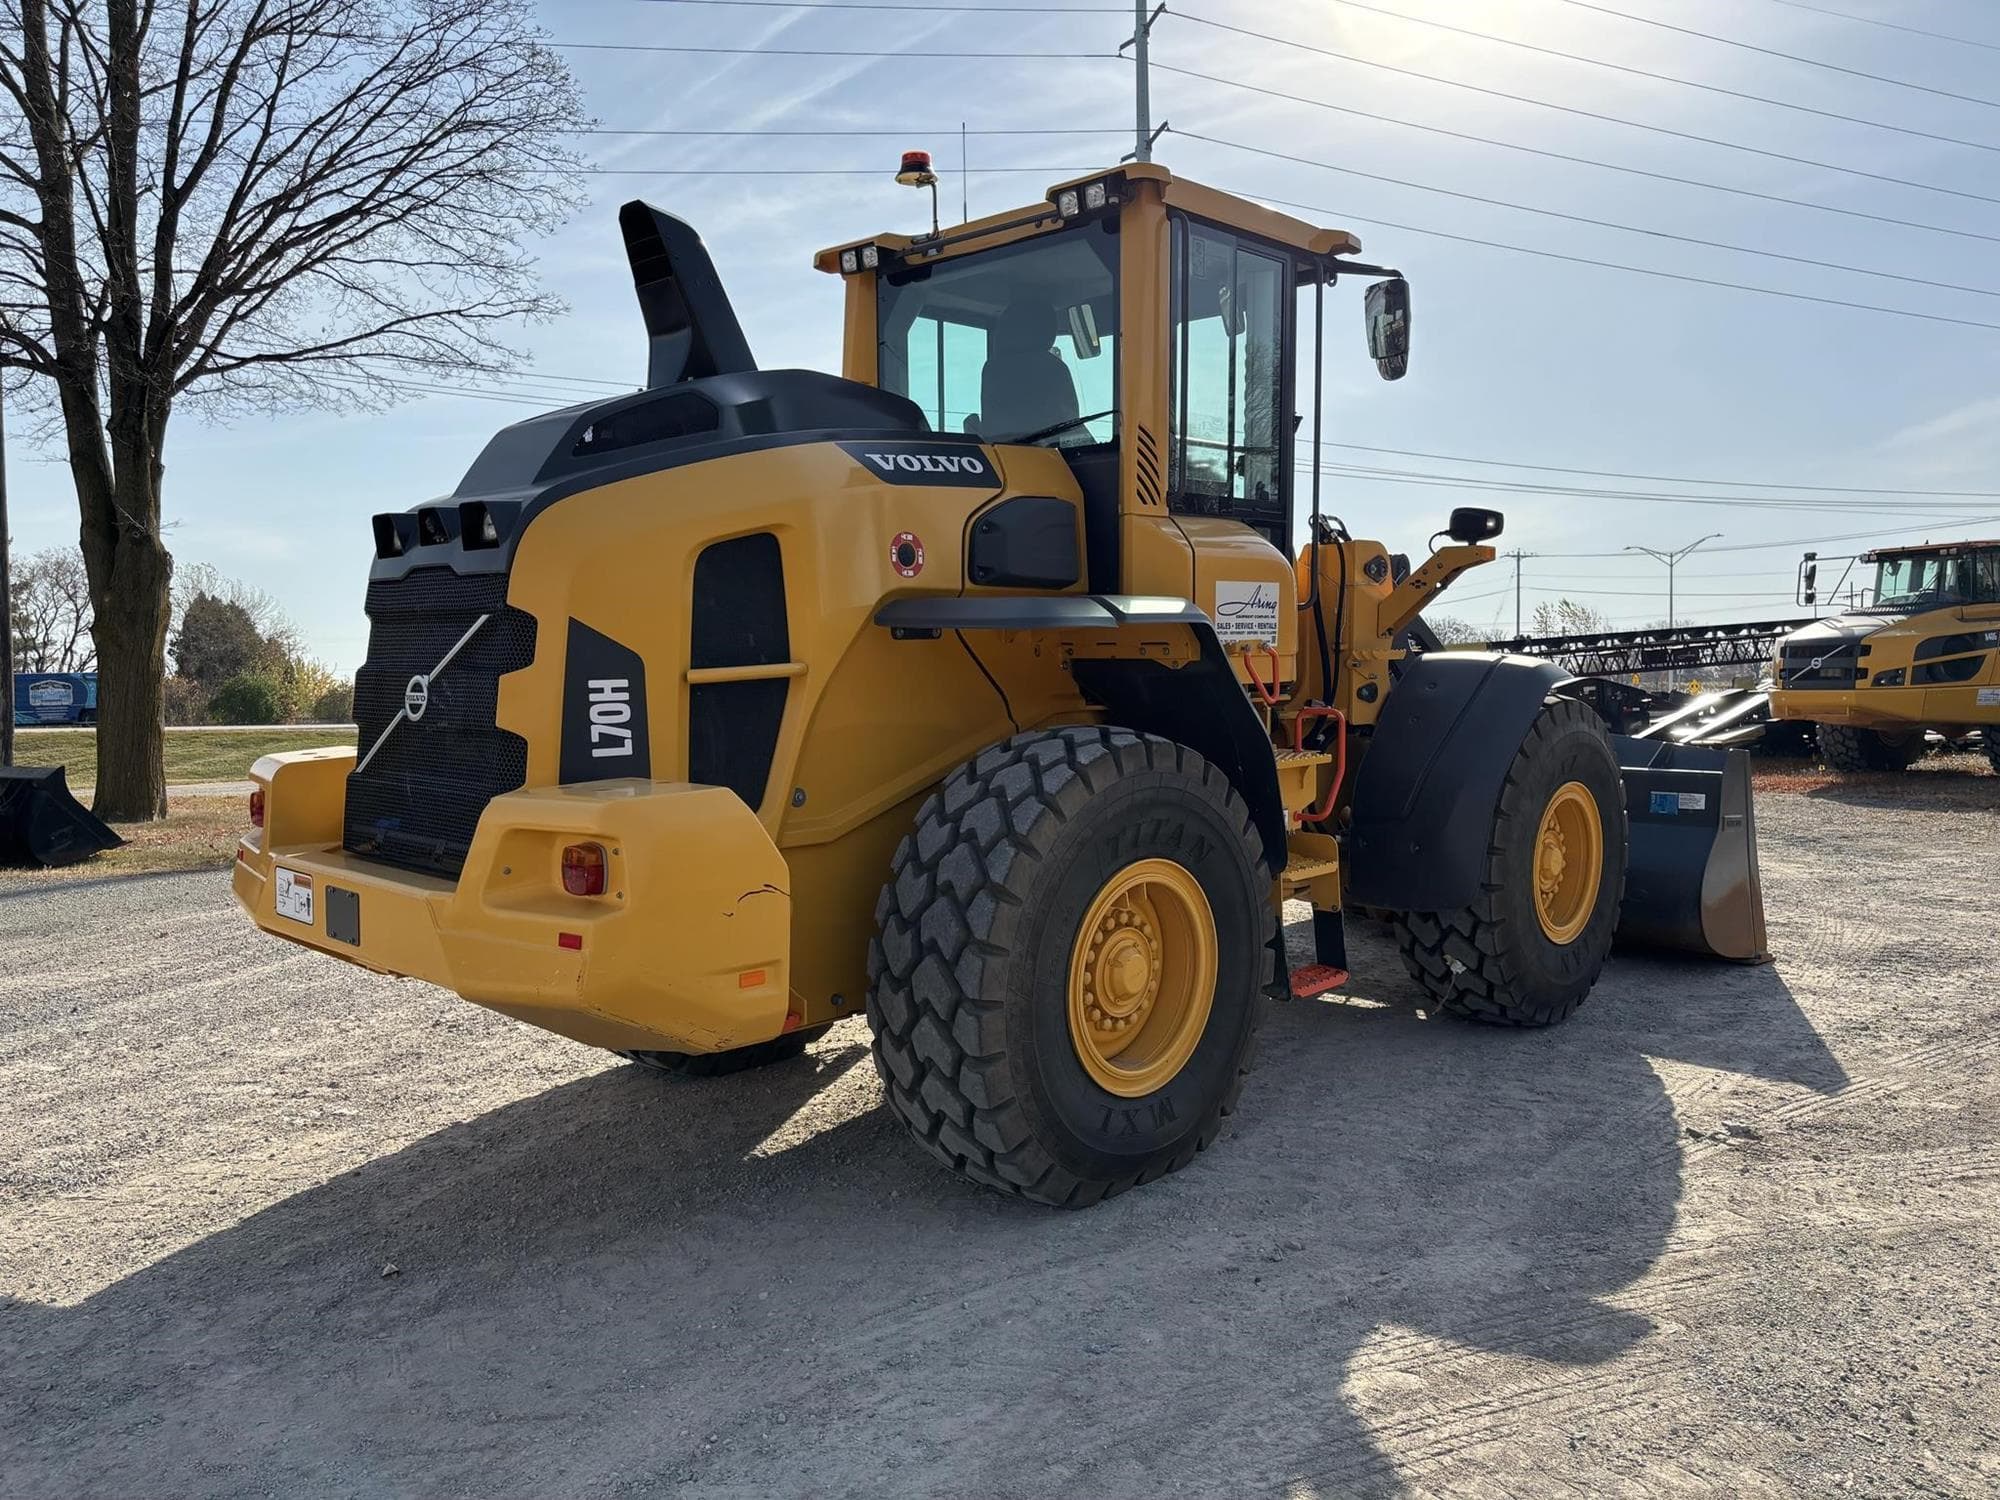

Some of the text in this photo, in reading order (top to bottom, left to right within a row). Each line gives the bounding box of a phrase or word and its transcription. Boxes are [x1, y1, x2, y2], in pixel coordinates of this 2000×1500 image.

[864, 453, 984, 474] VOLVO
[1217, 584, 1278, 616] Aring
[1216, 622, 1277, 630] SALES SERVICE RENTALS
[587, 678, 633, 758] L70H
[1106, 817, 1216, 861] TITAN
[1099, 1095, 1180, 1136] MXL
